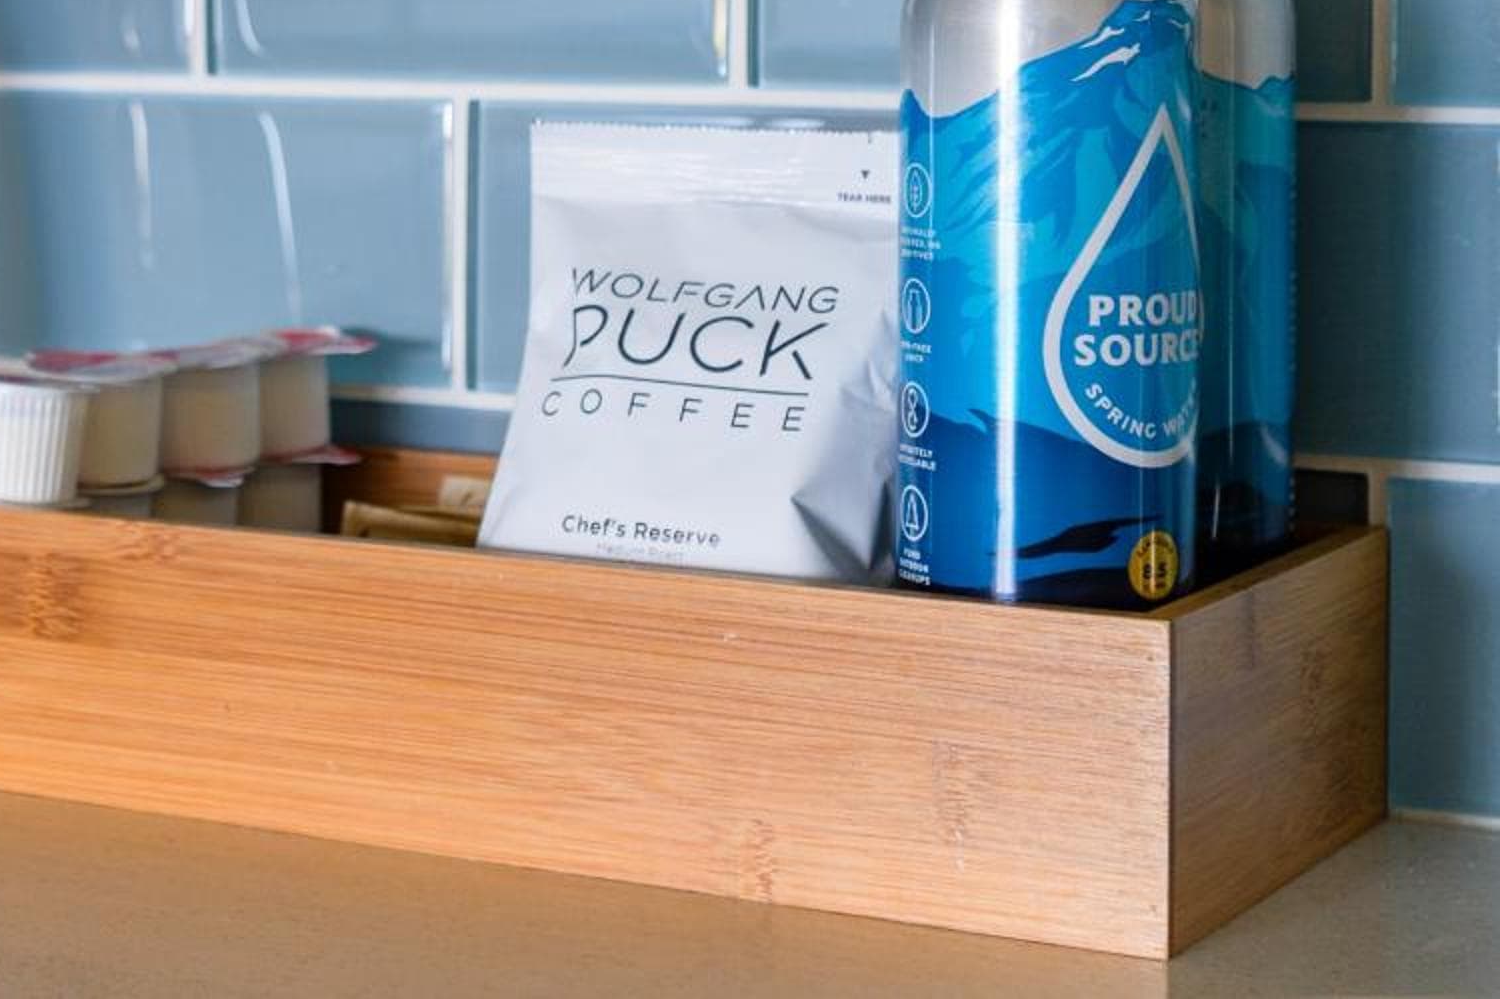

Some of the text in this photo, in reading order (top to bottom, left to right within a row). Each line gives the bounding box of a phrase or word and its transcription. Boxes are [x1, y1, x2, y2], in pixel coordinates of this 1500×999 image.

[571, 267, 840, 315] WOLFGANG
[562, 303, 830, 381] PUCK
[540, 388, 806, 432] COFFEE
[1084, 382, 1158, 439] SPRING
[561, 513, 722, 548] Chef's Reserve
